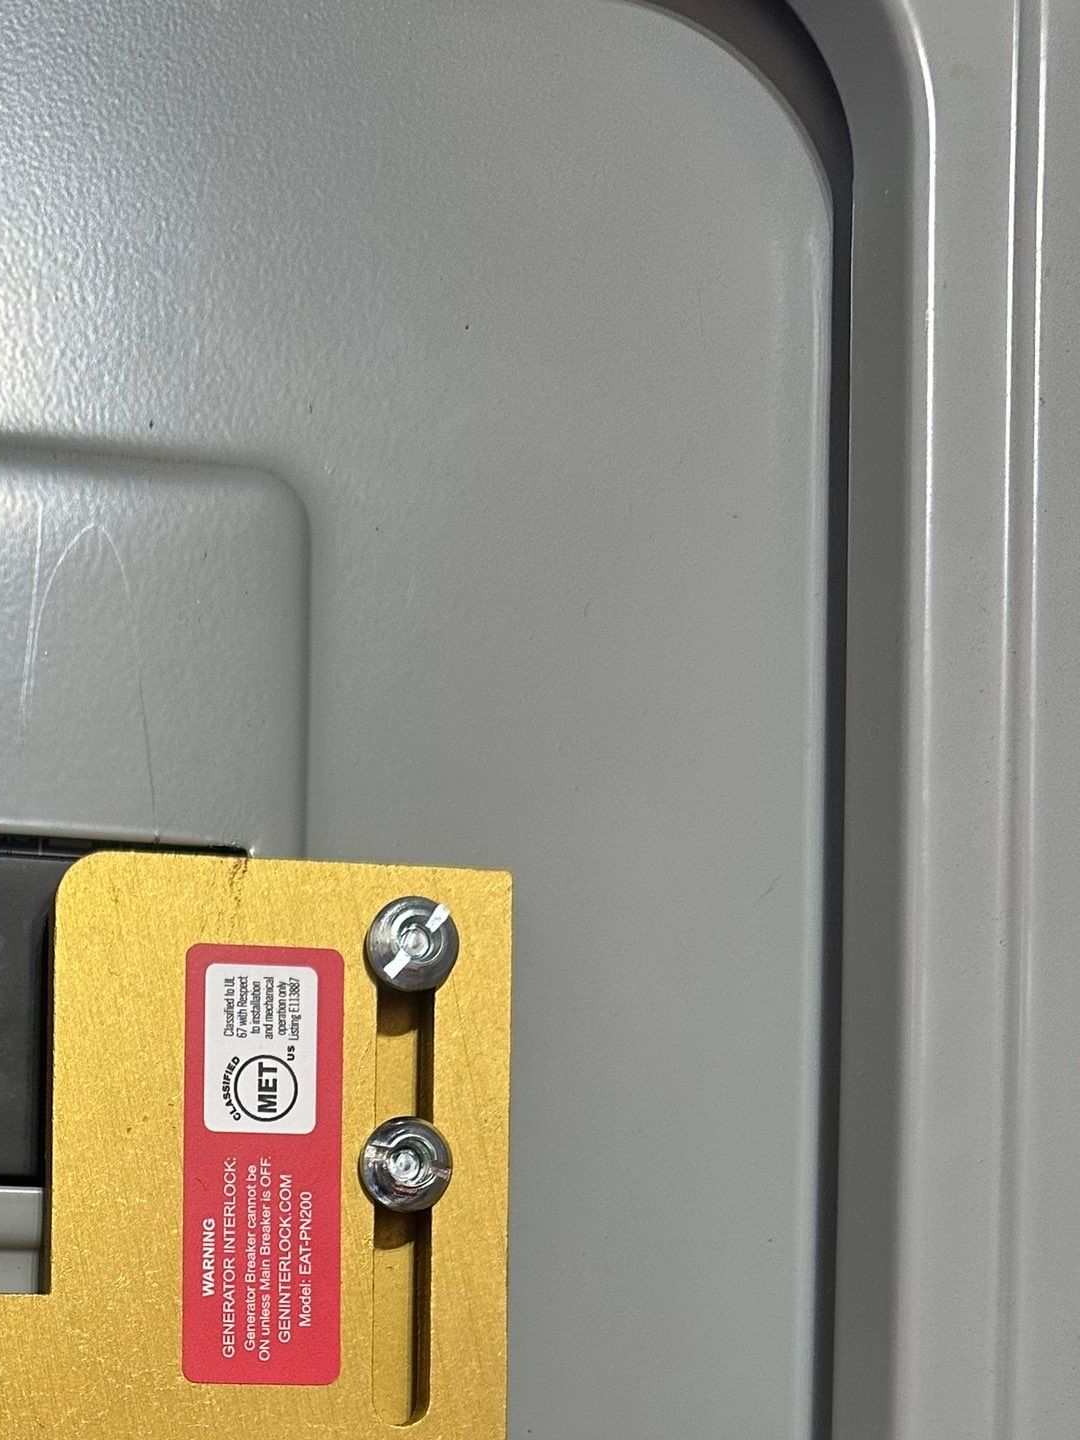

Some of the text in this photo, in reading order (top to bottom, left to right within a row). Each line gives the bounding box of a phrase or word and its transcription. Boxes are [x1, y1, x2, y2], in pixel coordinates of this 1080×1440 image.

[224, 976, 235, 987] UL
[237, 975, 251, 1038] 67 with Respect
[250, 981, 261, 1024] installation
[263, 976, 275, 1039] and mechanical
[277, 981, 289, 1035] operation only
[289, 976, 302, 1040] Listing E113887
[223, 998, 235, 1037] Classified
[287, 1045, 295, 1061] US
[222, 1056, 242, 1121] CLASSIFIED
[258, 1061, 277, 1113] MET
[202, 1218, 215, 1297] WARNING
[223, 1157, 236, 1358] GENERATOR INTERLOCK:
[245, 1165, 257, 1351] Generator Breaker cannot be
[259, 1156, 272, 1361] ON unless Main Breaker is OFF.
[278, 1174, 292, 1343] GENINTERLOCK.COM
[299, 1190, 312, 1327] Model: EAT-PN200
